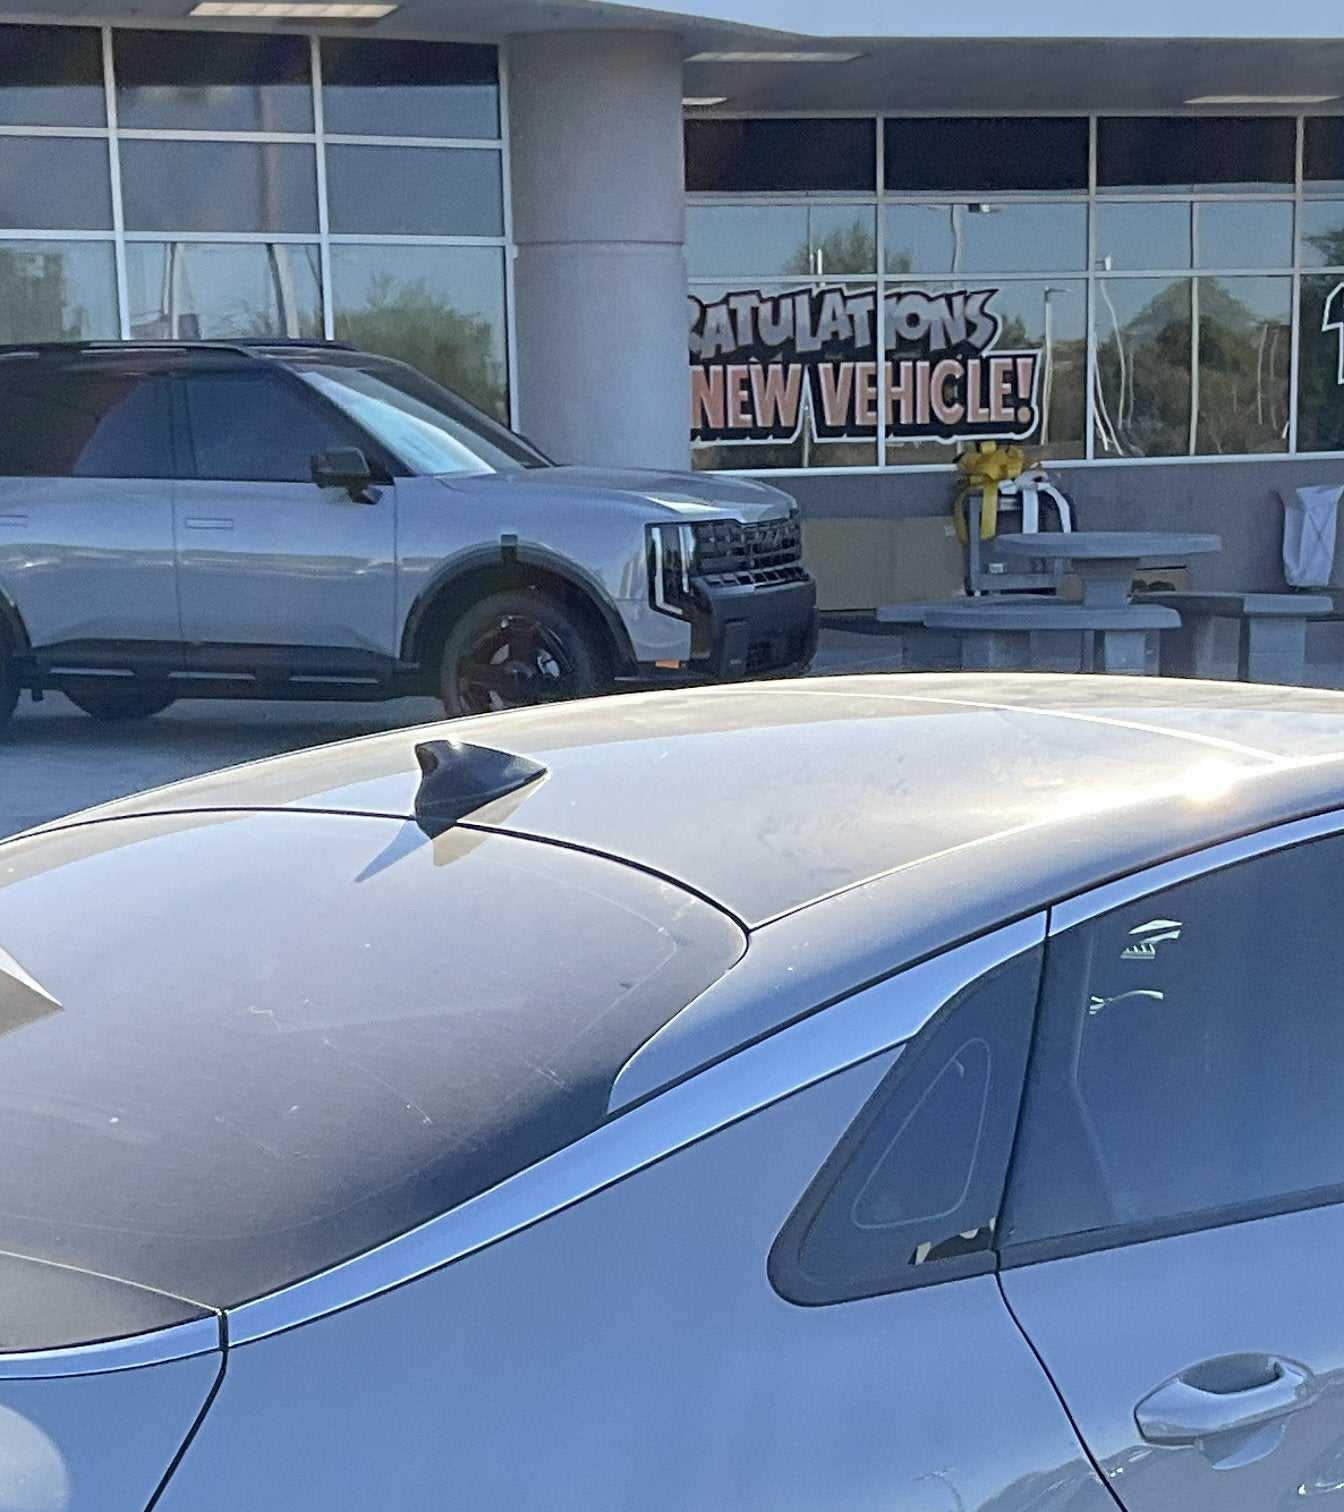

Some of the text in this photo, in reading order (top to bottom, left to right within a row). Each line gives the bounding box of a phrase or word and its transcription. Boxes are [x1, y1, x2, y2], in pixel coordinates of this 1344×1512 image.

[688, 290, 998, 359] RATULATIONS
[690, 357, 1035, 429] NEW VEHICLE!
